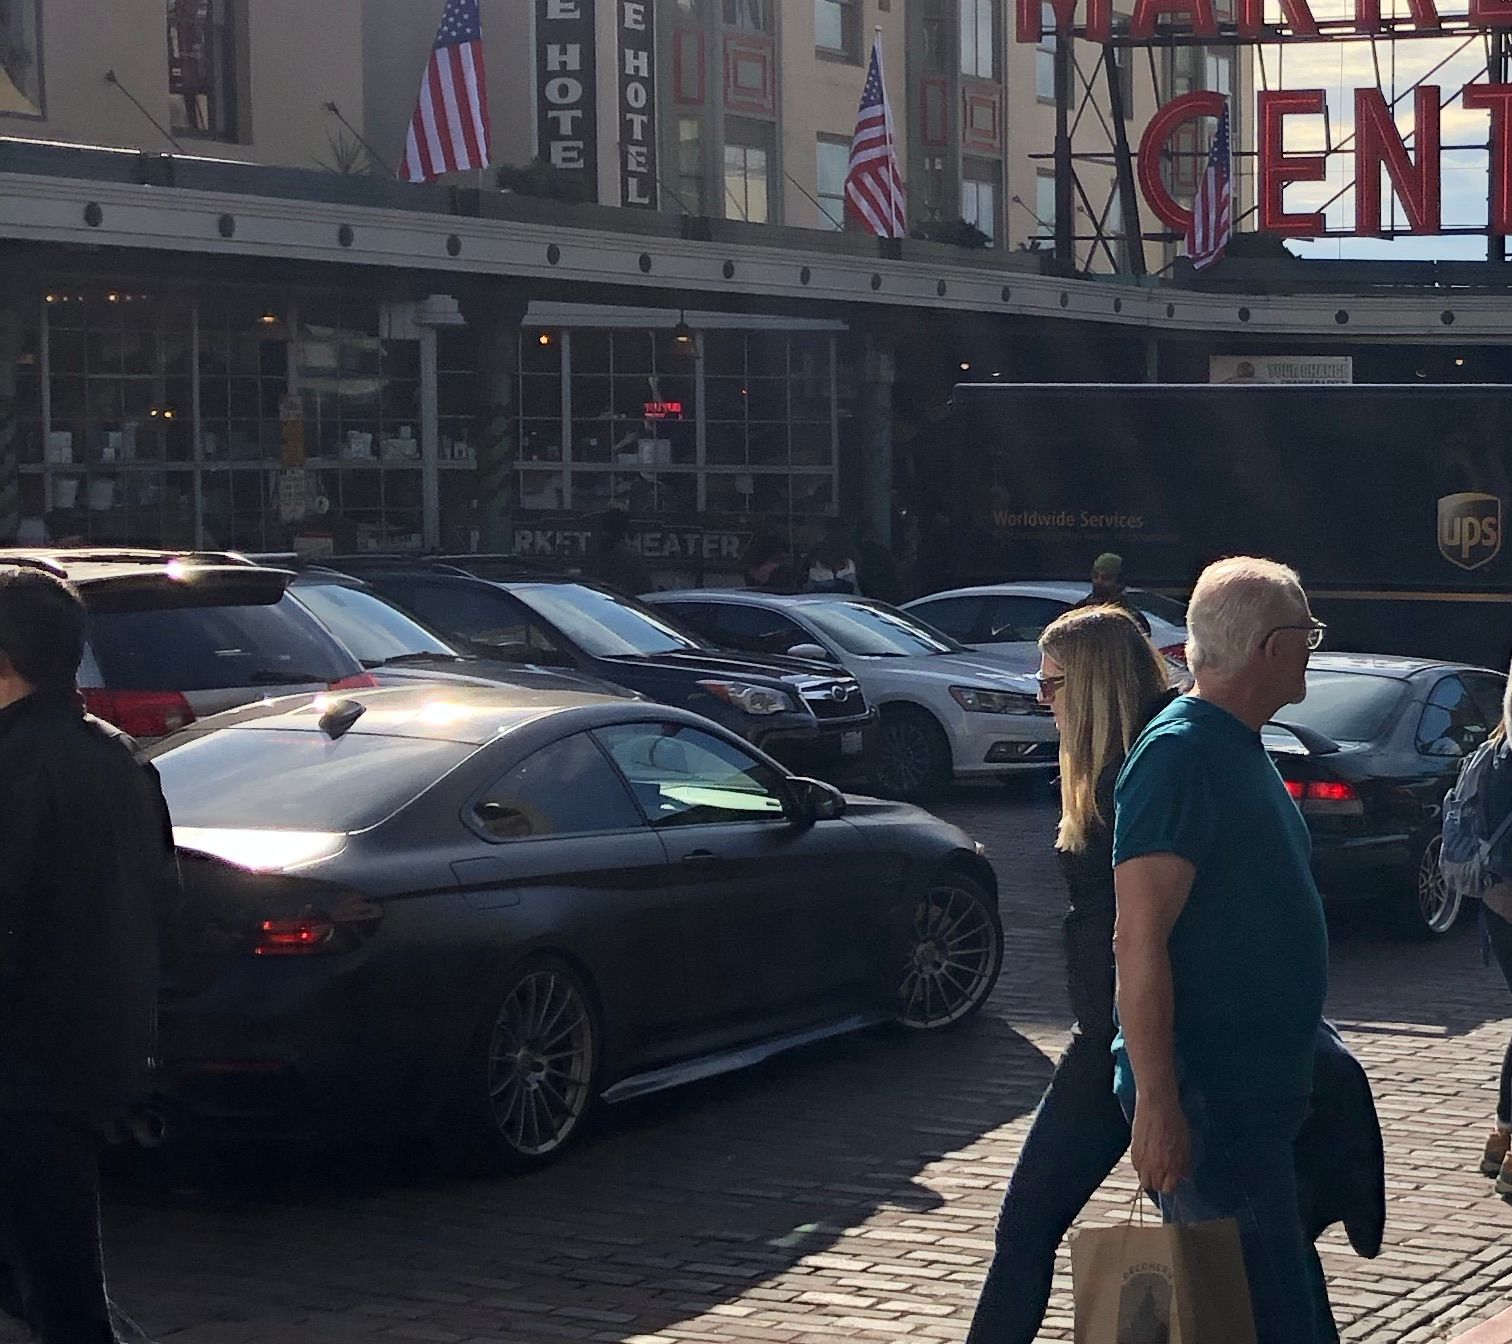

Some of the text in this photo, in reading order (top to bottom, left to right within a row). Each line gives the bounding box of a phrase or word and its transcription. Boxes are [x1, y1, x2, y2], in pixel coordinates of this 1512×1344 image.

[544, 43, 585, 170] HOTE
[624, 49, 650, 205] HOTEL
[992, 510, 1144, 529] Worldwide Services
[1443, 515, 1498, 559] ups
[470, 529, 742, 558] RKET HEATER
